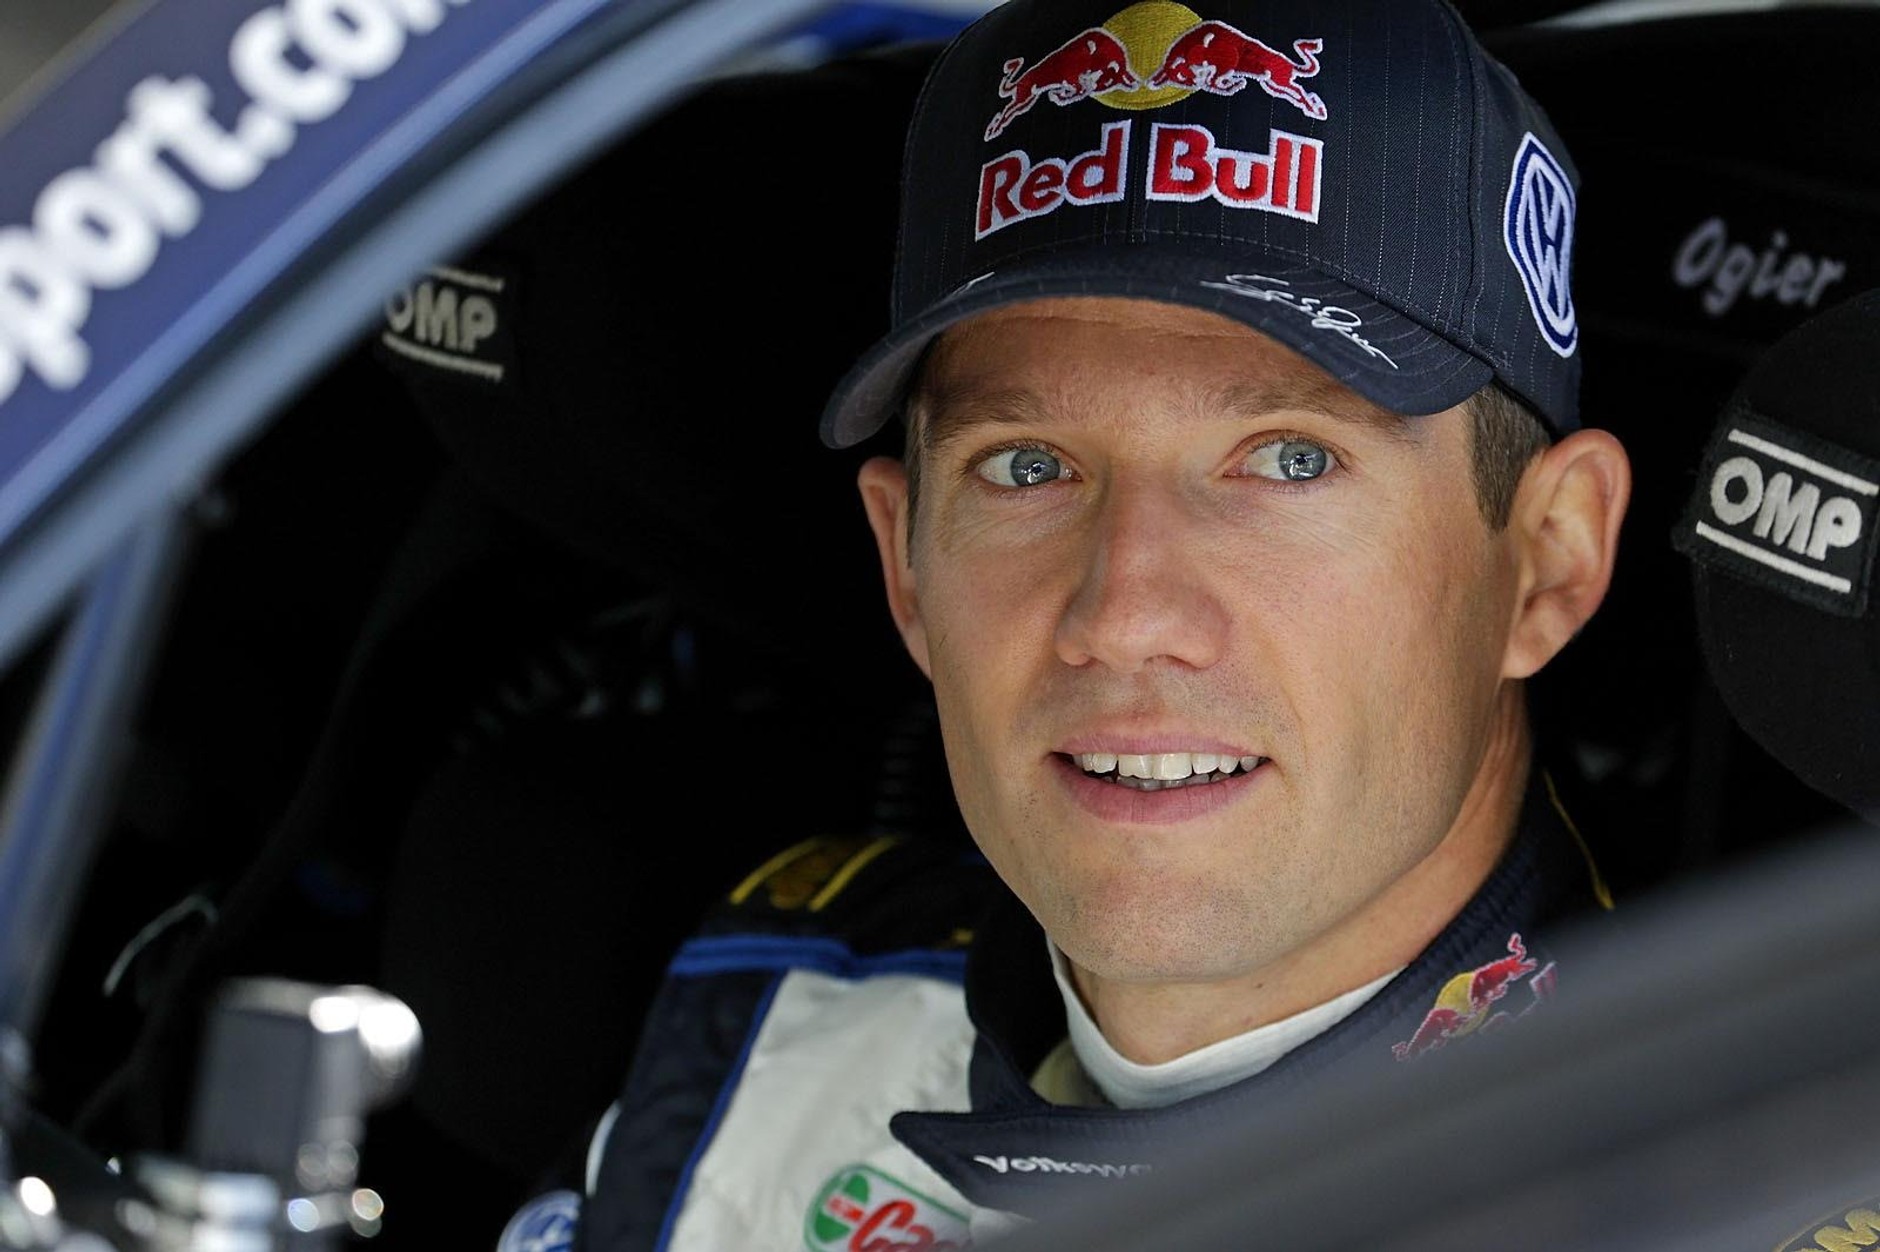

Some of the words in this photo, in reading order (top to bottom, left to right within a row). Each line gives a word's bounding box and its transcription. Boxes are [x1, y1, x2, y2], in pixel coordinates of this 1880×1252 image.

[975, 118, 1131, 241] Red
[1145, 122, 1325, 225] Bull
[1672, 215, 1847, 317] Ogier
[1709, 456, 1863, 561] OMP
